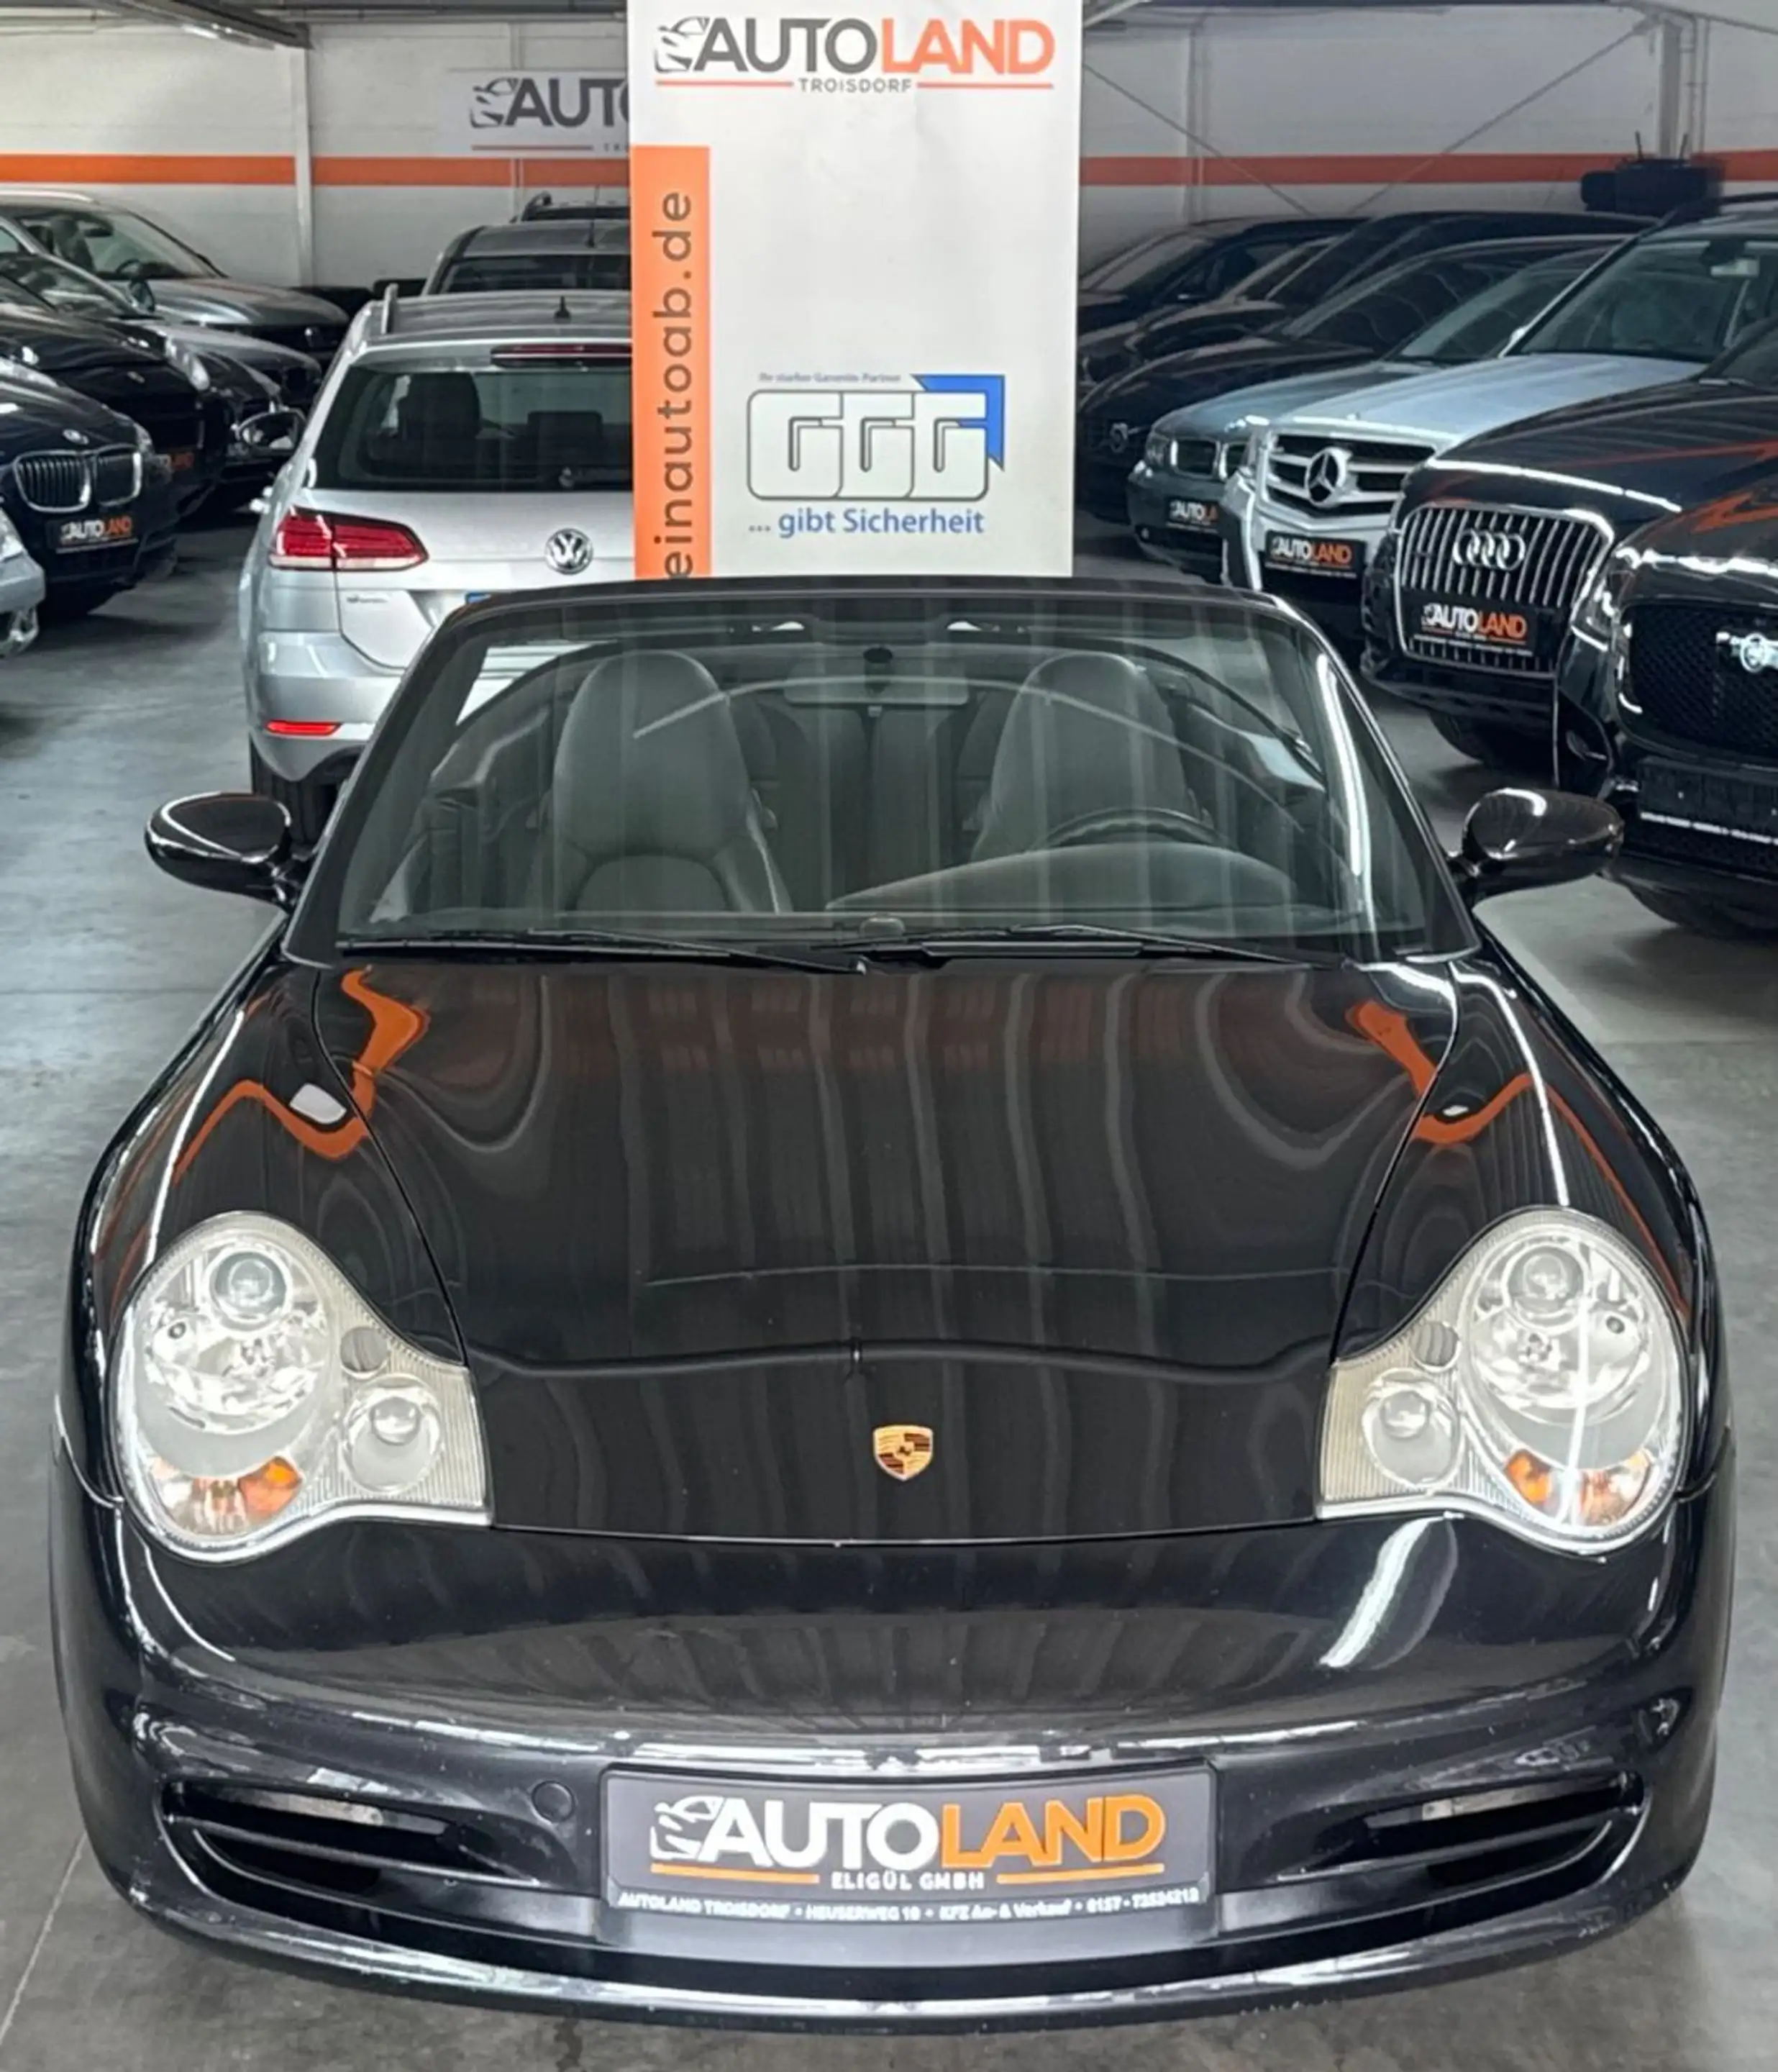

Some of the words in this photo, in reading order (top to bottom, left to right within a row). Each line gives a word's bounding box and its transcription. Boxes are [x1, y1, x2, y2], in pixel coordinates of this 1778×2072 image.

[693, 18, 1056, 74] AUTOLAND
[798, 78, 913, 93] TROISDORF
[504, 78, 629, 128] AUT
[778, 507, 836, 539] gibt
[843, 507, 985, 534] Sicherheit
[1275, 537, 1353, 565] AUTOLAND
[1430, 603, 1528, 640] AUTOLAND
[698, 1796, 1167, 1869] AUTOLAND
[831, 1869, 912, 1890] ELIGÜL
[918, 1872, 985, 1890] GMBH
